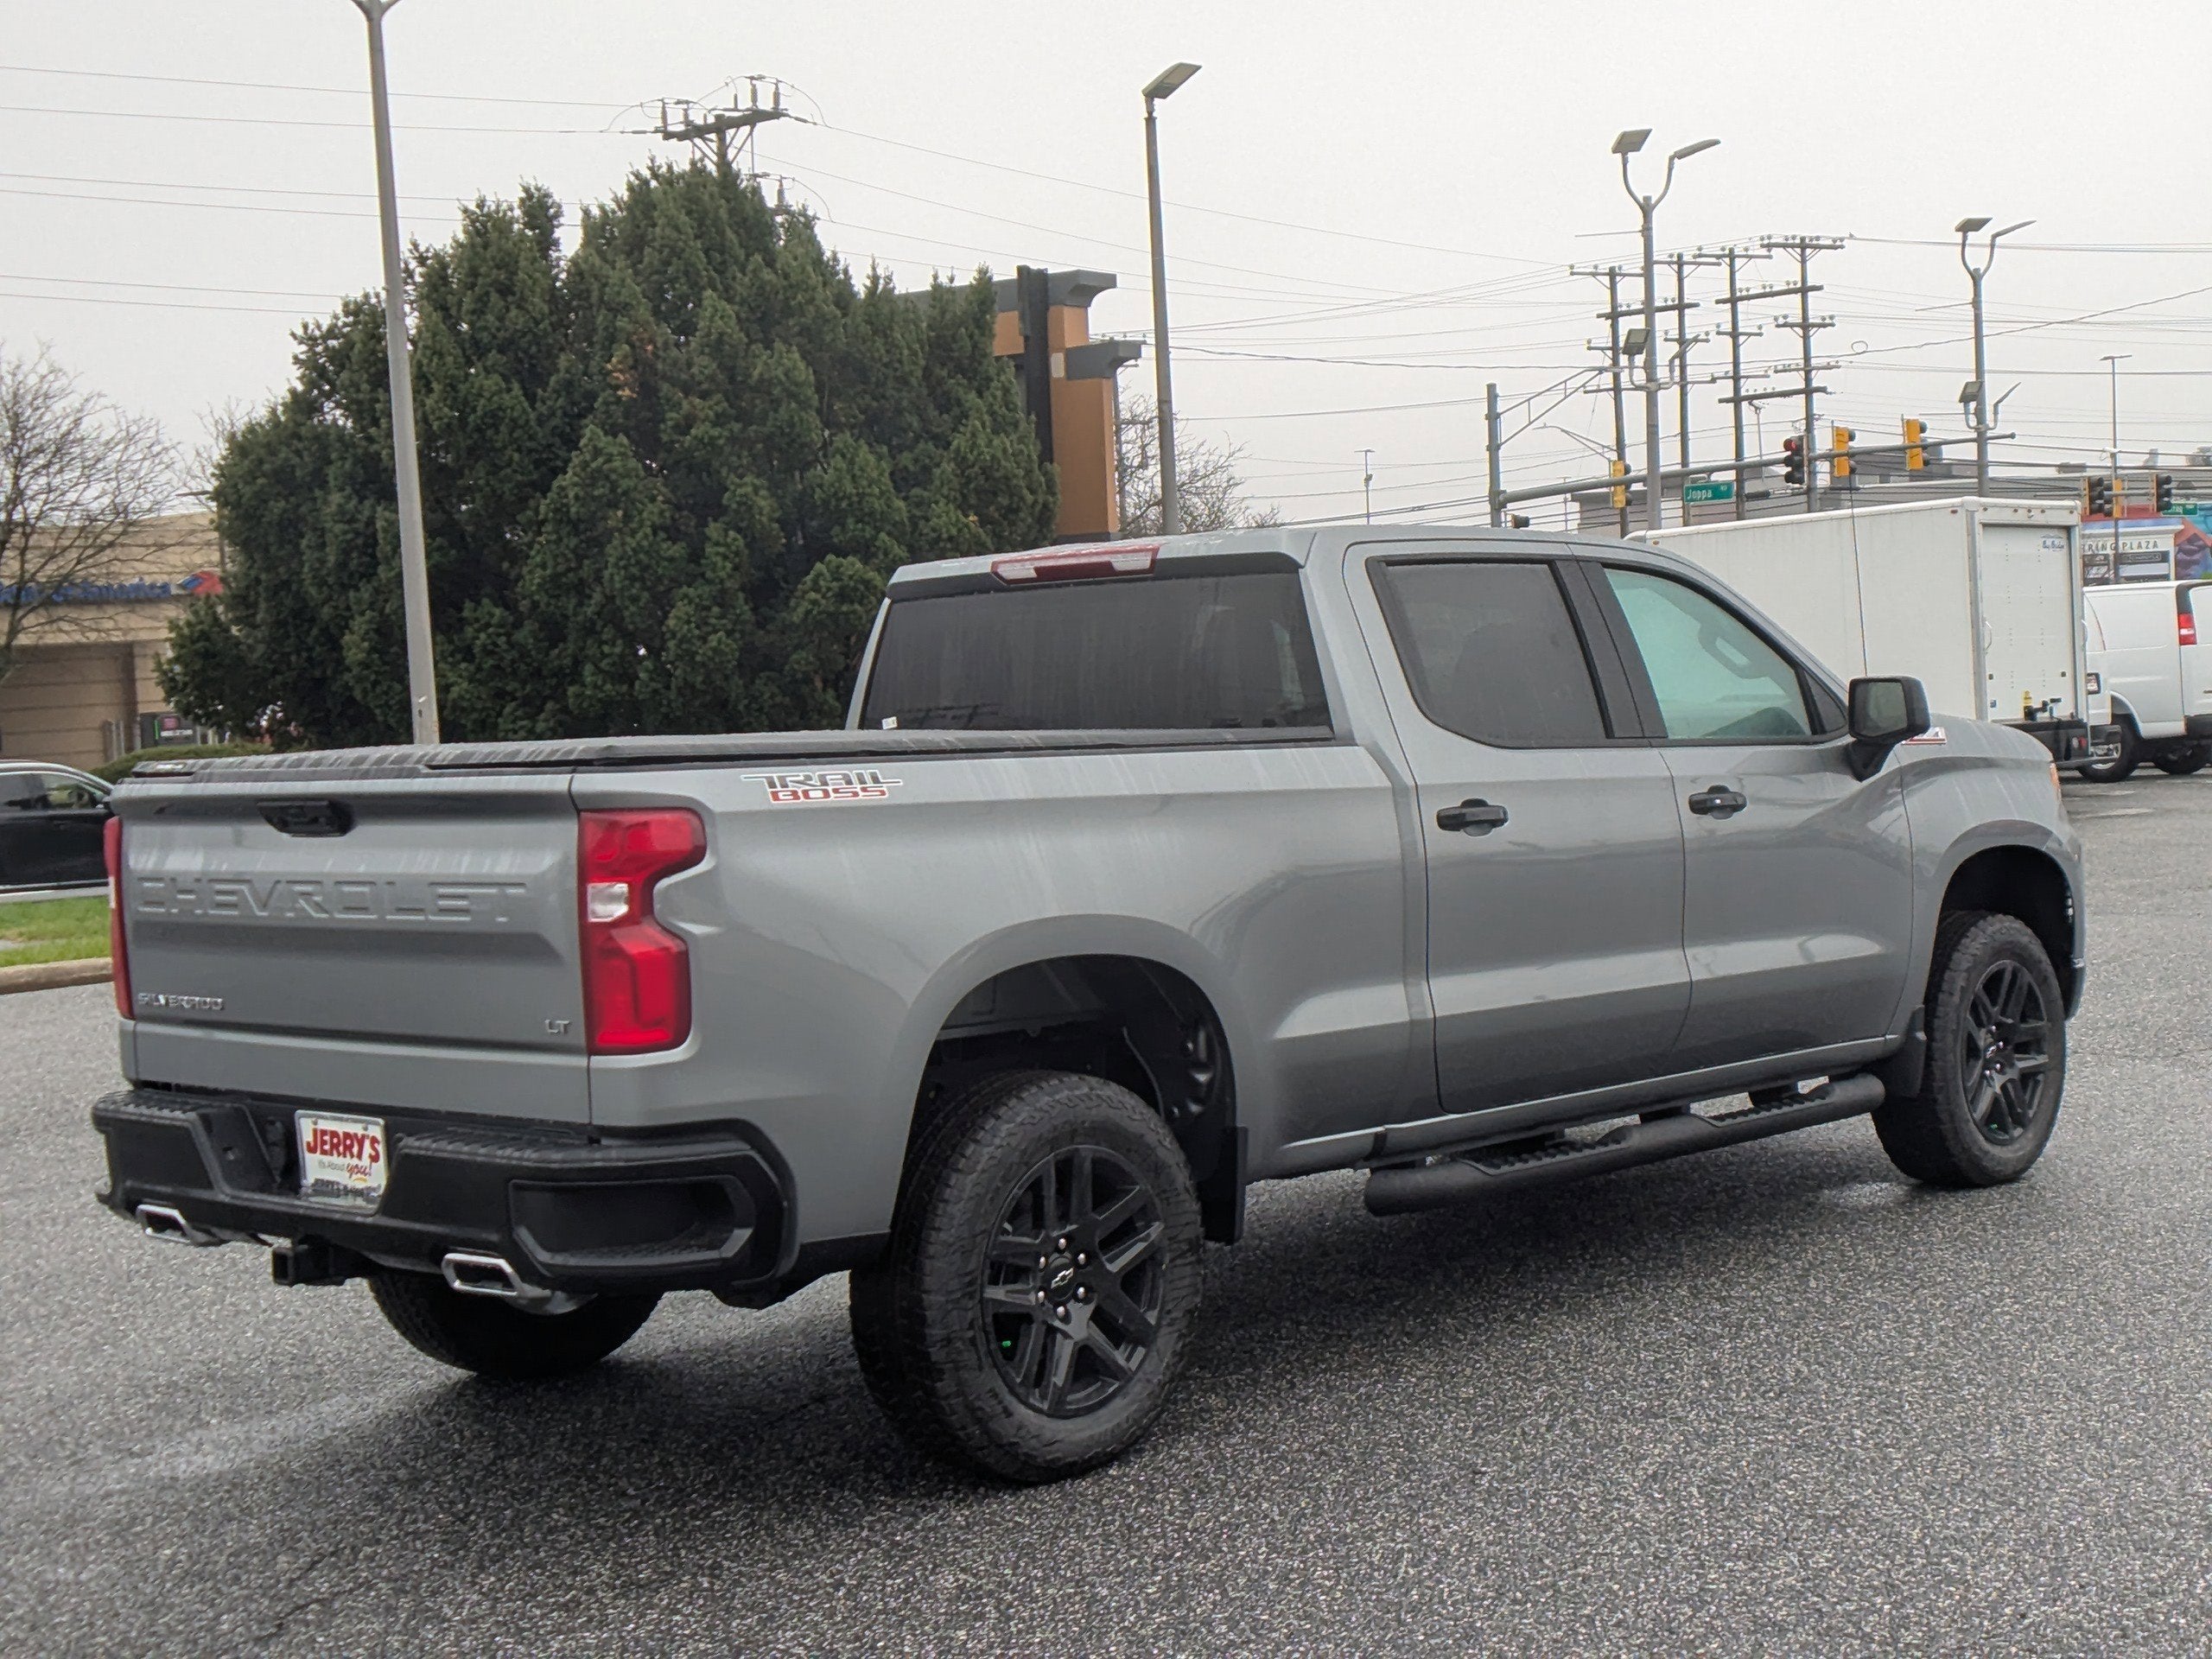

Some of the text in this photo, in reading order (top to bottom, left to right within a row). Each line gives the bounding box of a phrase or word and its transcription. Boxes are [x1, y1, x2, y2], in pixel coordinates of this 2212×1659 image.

[1687, 489, 1713, 499] Joppa
[2122, 540, 2159, 552] PLAZA
[741, 769, 903, 791] TRAIL
[768, 784, 888, 804] BOSS
[137, 876, 528, 923] CHEVROLET
[544, 1019, 569, 1034] LT
[306, 1128, 380, 1163] JERRY'S
